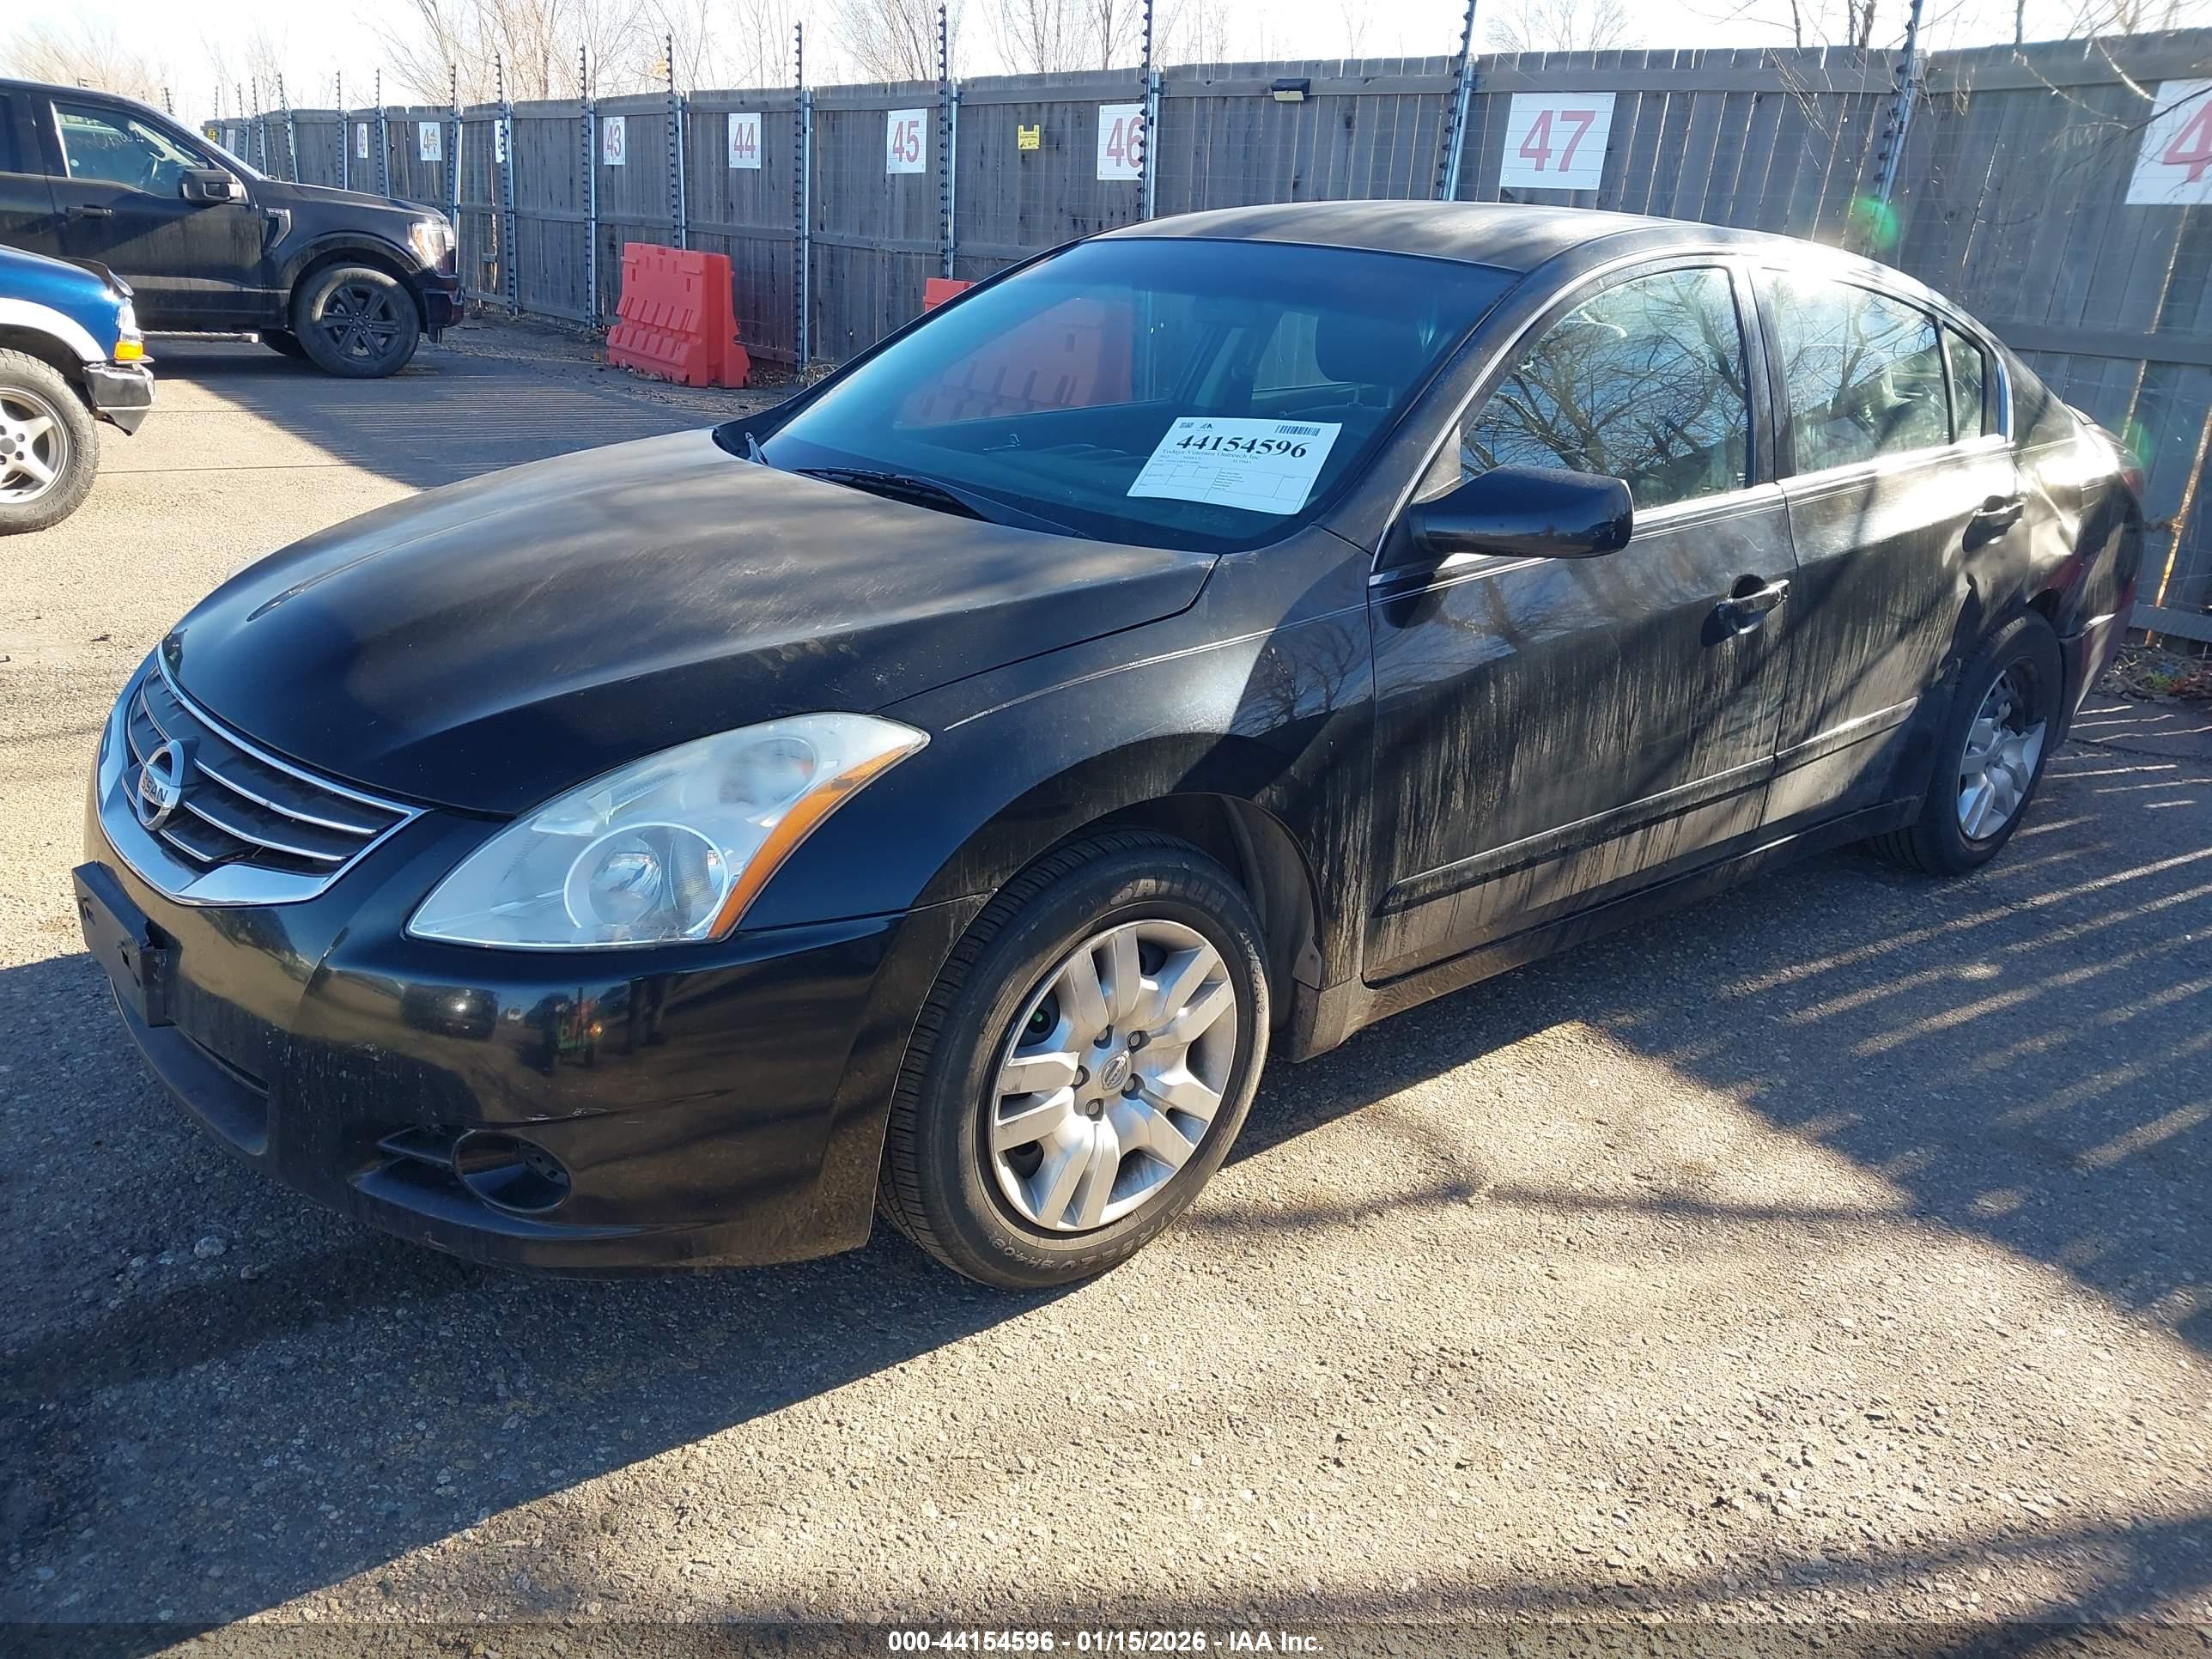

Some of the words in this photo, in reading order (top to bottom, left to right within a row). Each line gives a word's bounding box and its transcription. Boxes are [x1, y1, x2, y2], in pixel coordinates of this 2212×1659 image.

[606, 125, 622, 157] 43
[733, 122, 757, 160] 44
[892, 120, 920, 163] 45
[1106, 116, 1144, 168] 46
[1518, 109, 1596, 173] 47
[2162, 100, 2212, 183] 4
[1176, 434, 1313, 459] 44154596
[1109, 878, 1227, 913] SAILUN
